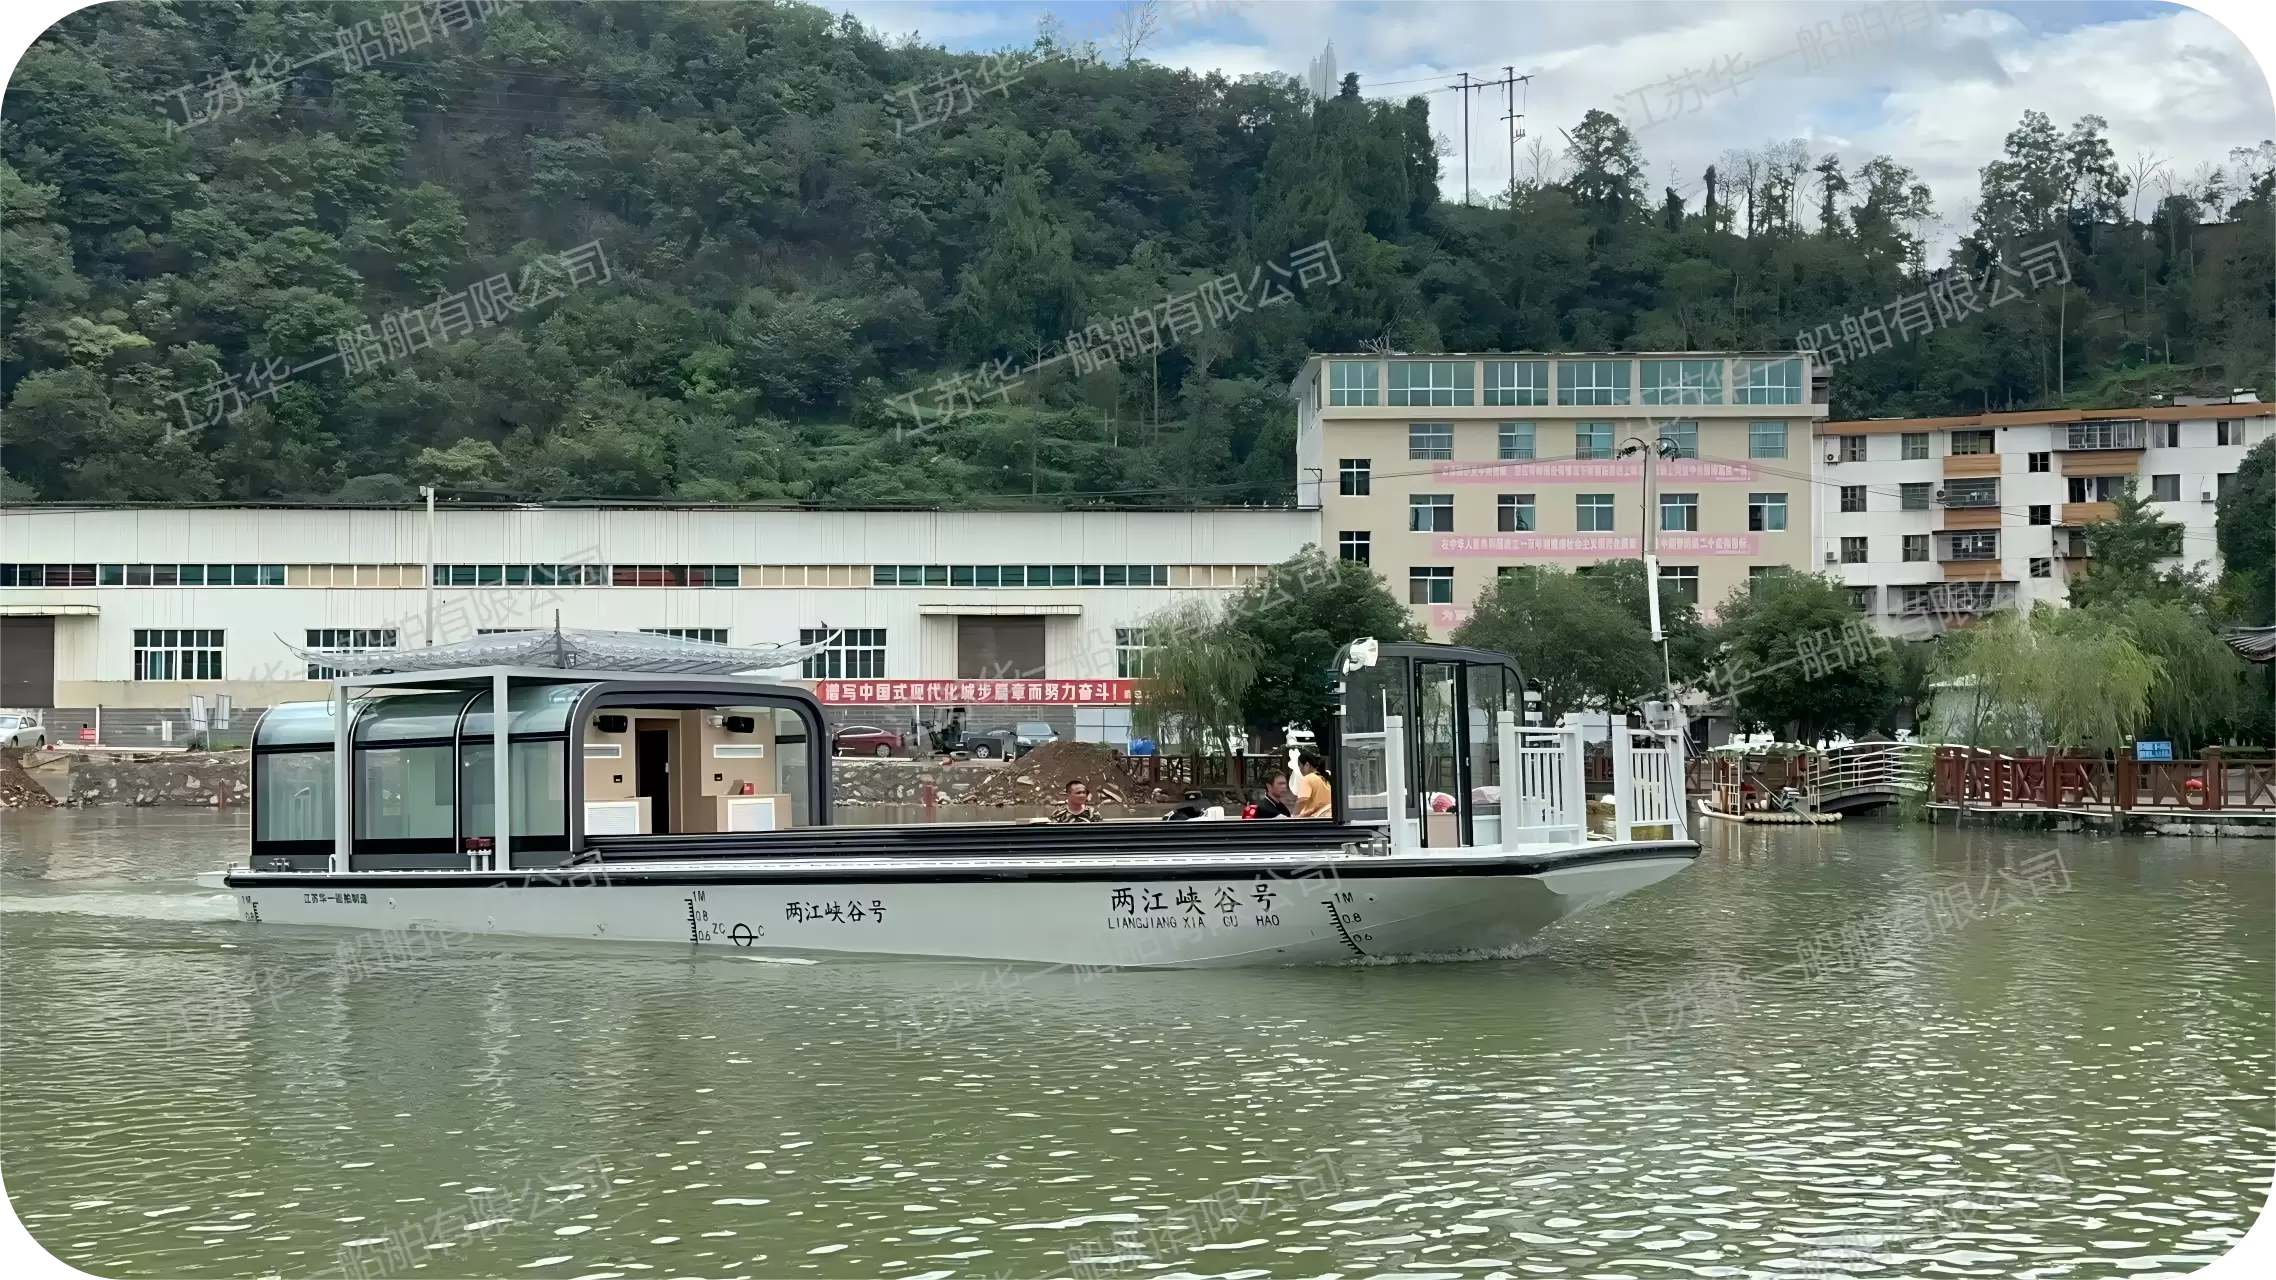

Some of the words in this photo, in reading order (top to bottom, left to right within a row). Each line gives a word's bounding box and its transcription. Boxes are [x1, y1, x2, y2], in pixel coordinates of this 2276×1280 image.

[693, 890, 706, 902] 1M
[1110, 883, 1277, 916] 两江峡谷号
[1334, 891, 1354, 904] 1M
[785, 899, 887, 924] 两江峡谷号
[1342, 912, 1362, 924] 0.8
[1107, 915, 1178, 930] LIANGJIANG
[1182, 916, 1206, 929] XIA
[1256, 914, 1280, 927] HAO
